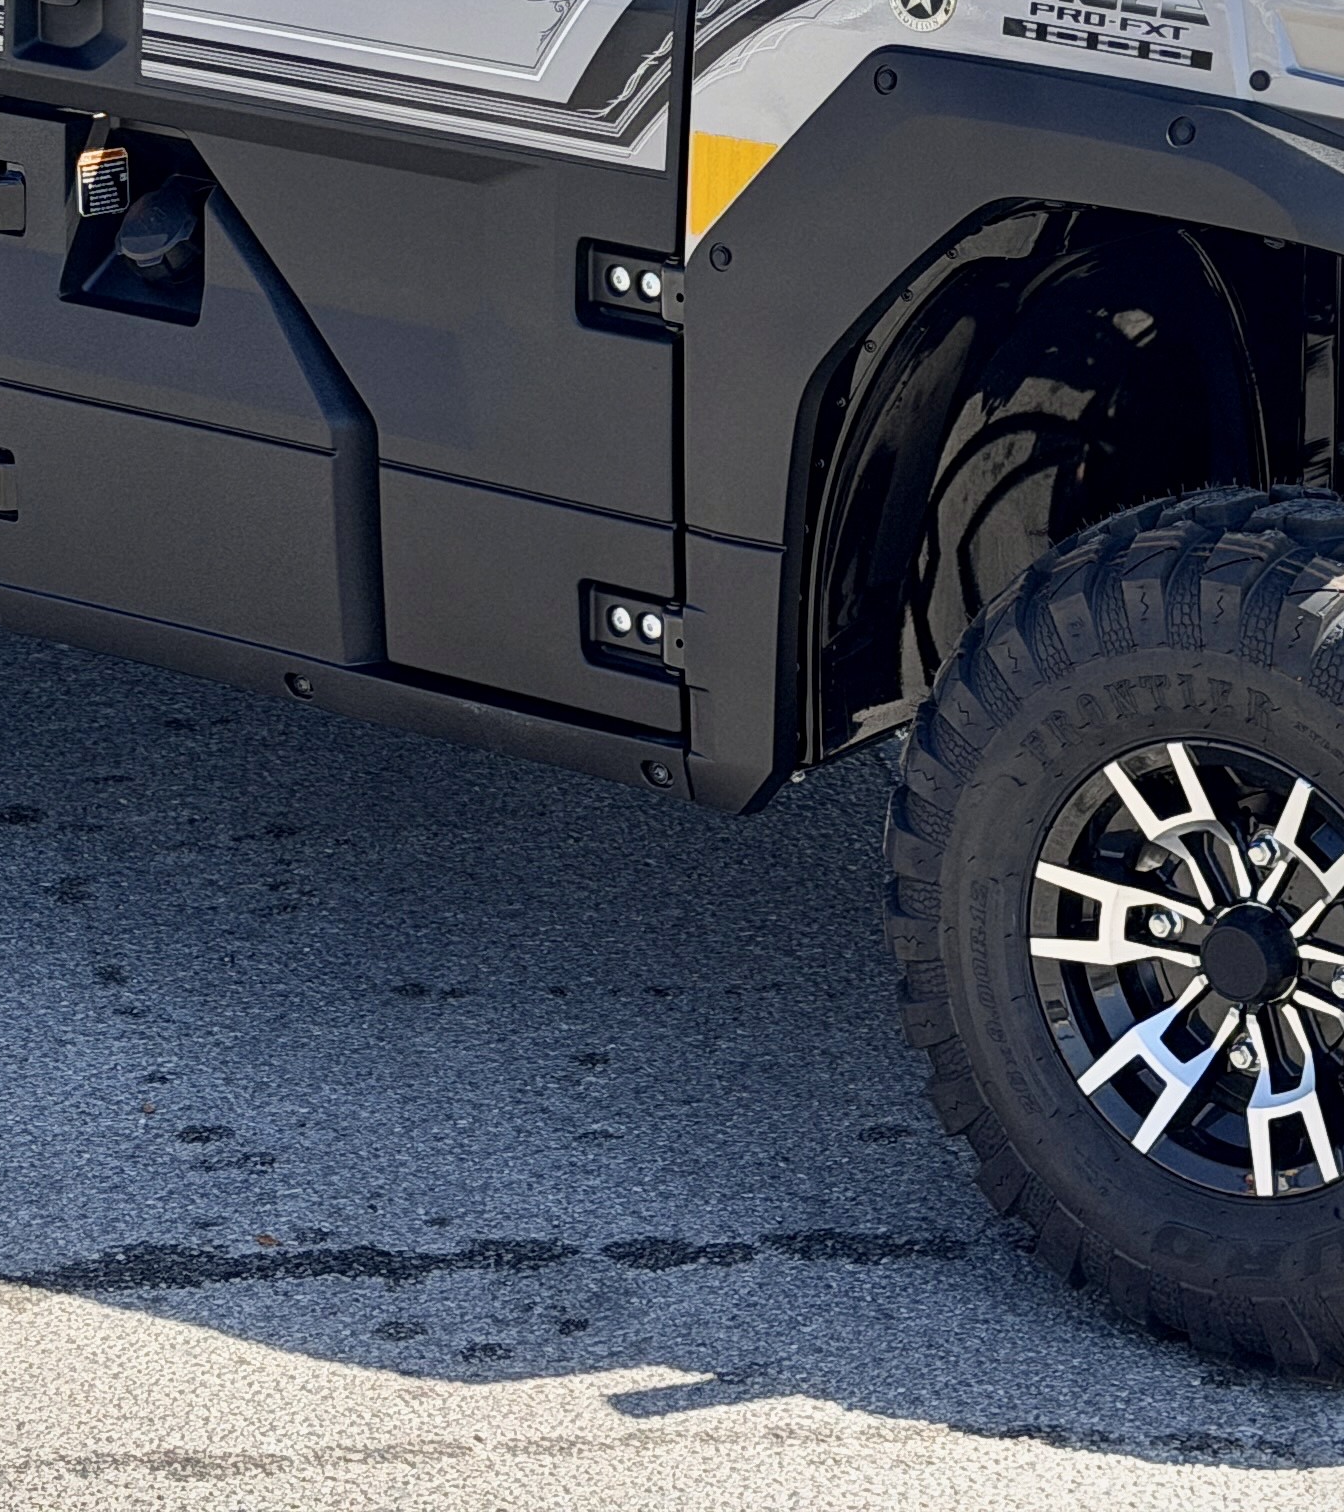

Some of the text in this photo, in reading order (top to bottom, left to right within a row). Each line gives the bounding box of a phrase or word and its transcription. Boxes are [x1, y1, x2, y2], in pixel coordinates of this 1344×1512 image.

[1020, 20, 1194, 66] 1000
[1030, 1, 1190, 41] PRO-FXT
[1020, 674, 1276, 765] FRONTIER
